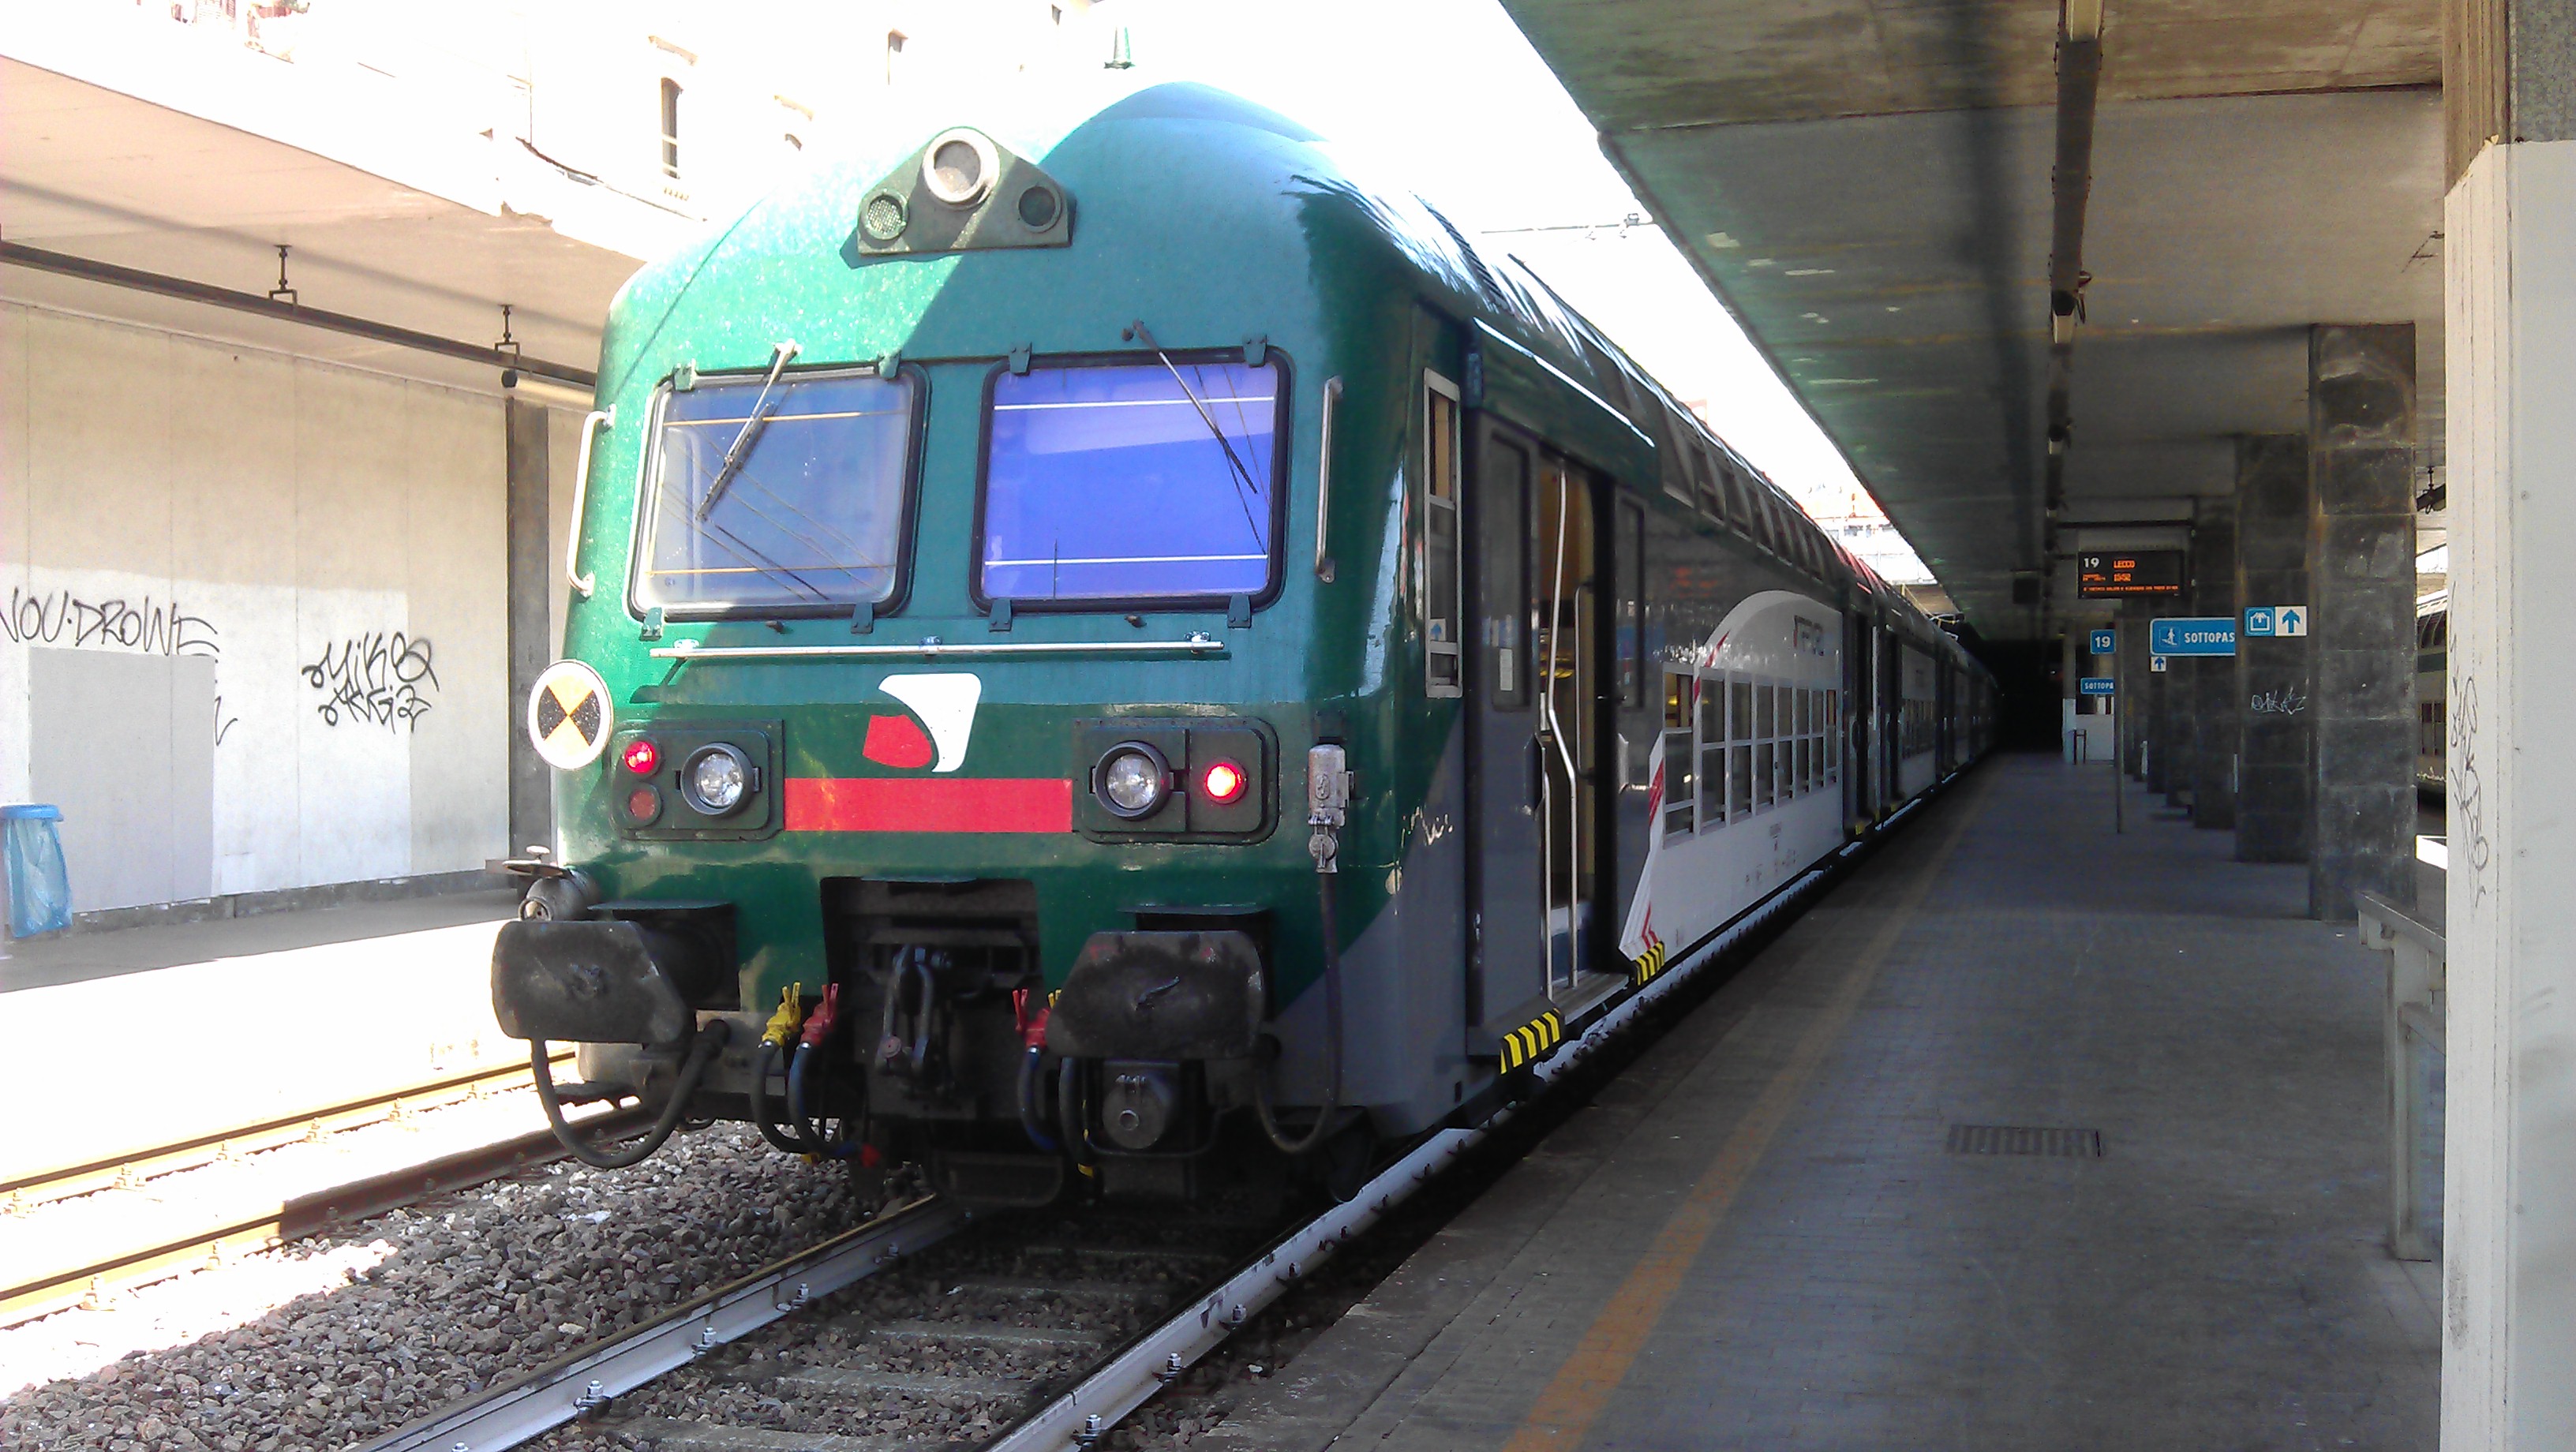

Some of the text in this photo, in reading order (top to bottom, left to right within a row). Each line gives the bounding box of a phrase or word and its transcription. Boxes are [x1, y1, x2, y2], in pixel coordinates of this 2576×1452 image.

[2084, 557, 2099, 568] 19
[2095, 635, 2111, 648] 19
[2184, 632, 2235, 643] SOTTOPAS
